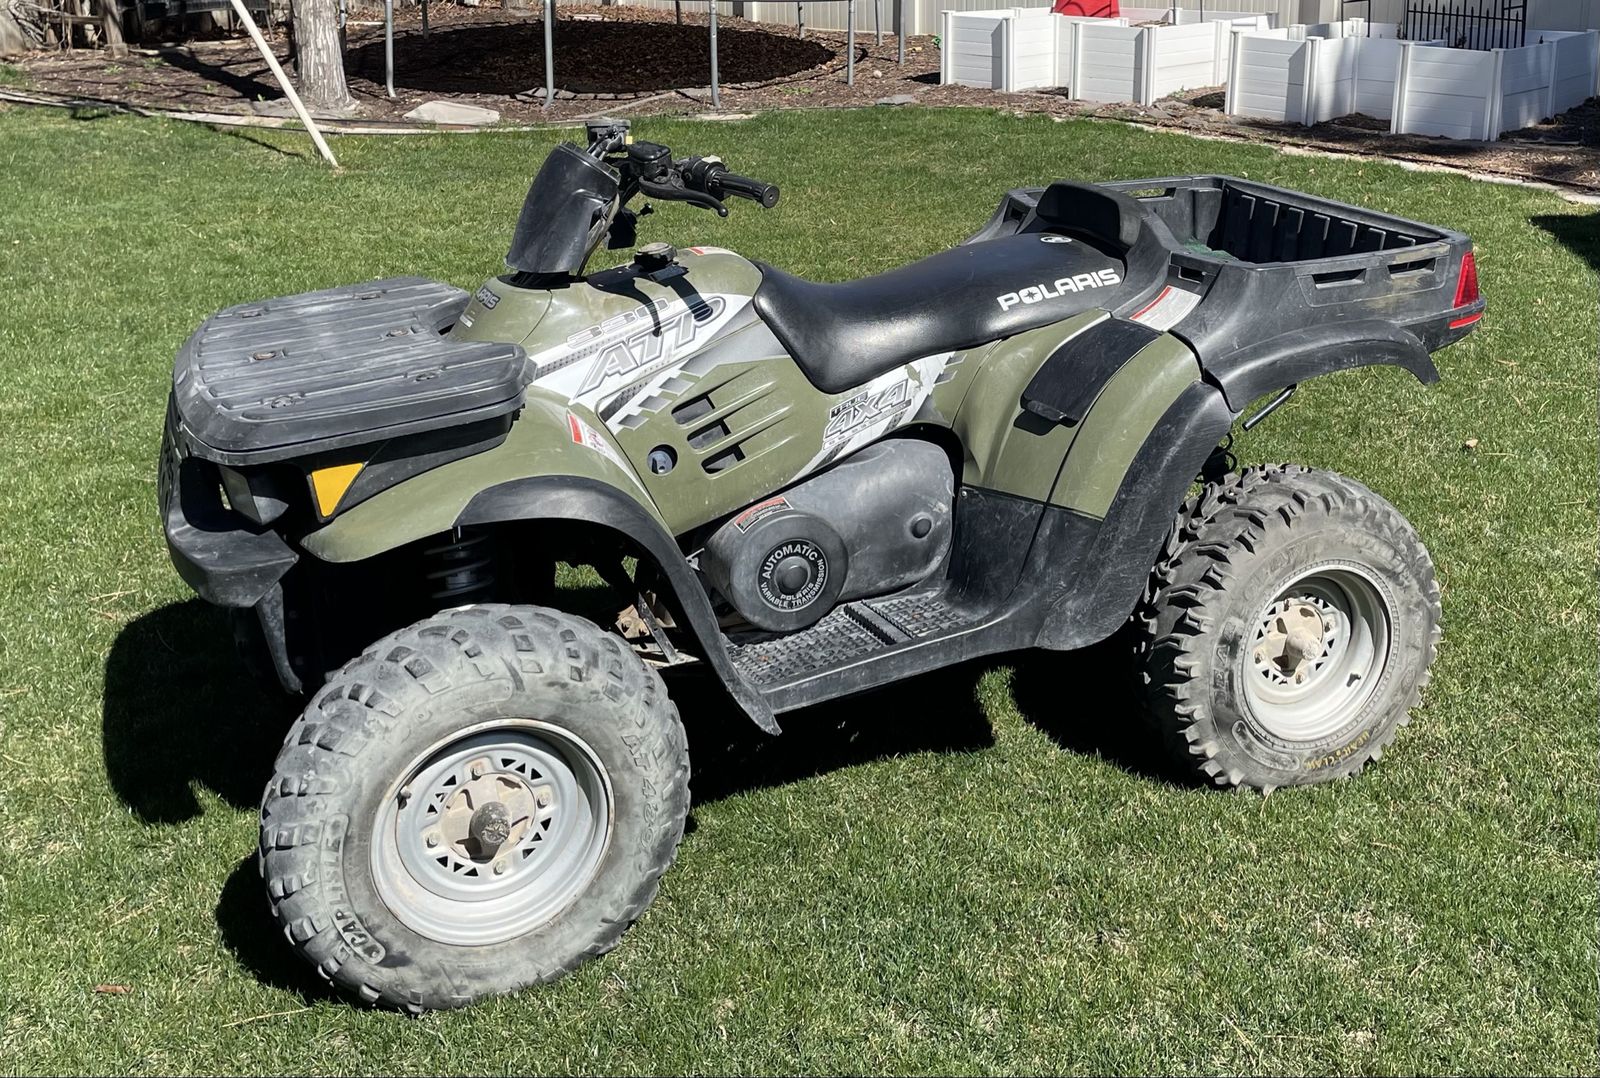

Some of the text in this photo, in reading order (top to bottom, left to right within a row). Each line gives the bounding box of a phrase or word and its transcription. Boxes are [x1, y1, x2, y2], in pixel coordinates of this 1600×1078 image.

[996, 268, 1121, 311] POLARIS
[761, 559, 825, 608] VARIABLE TRANSMISSION
[762, 544, 818, 580] AUTOMATIC
[780, 582, 814, 601] POLARIS
[326, 837, 368, 947] CARLISLE
